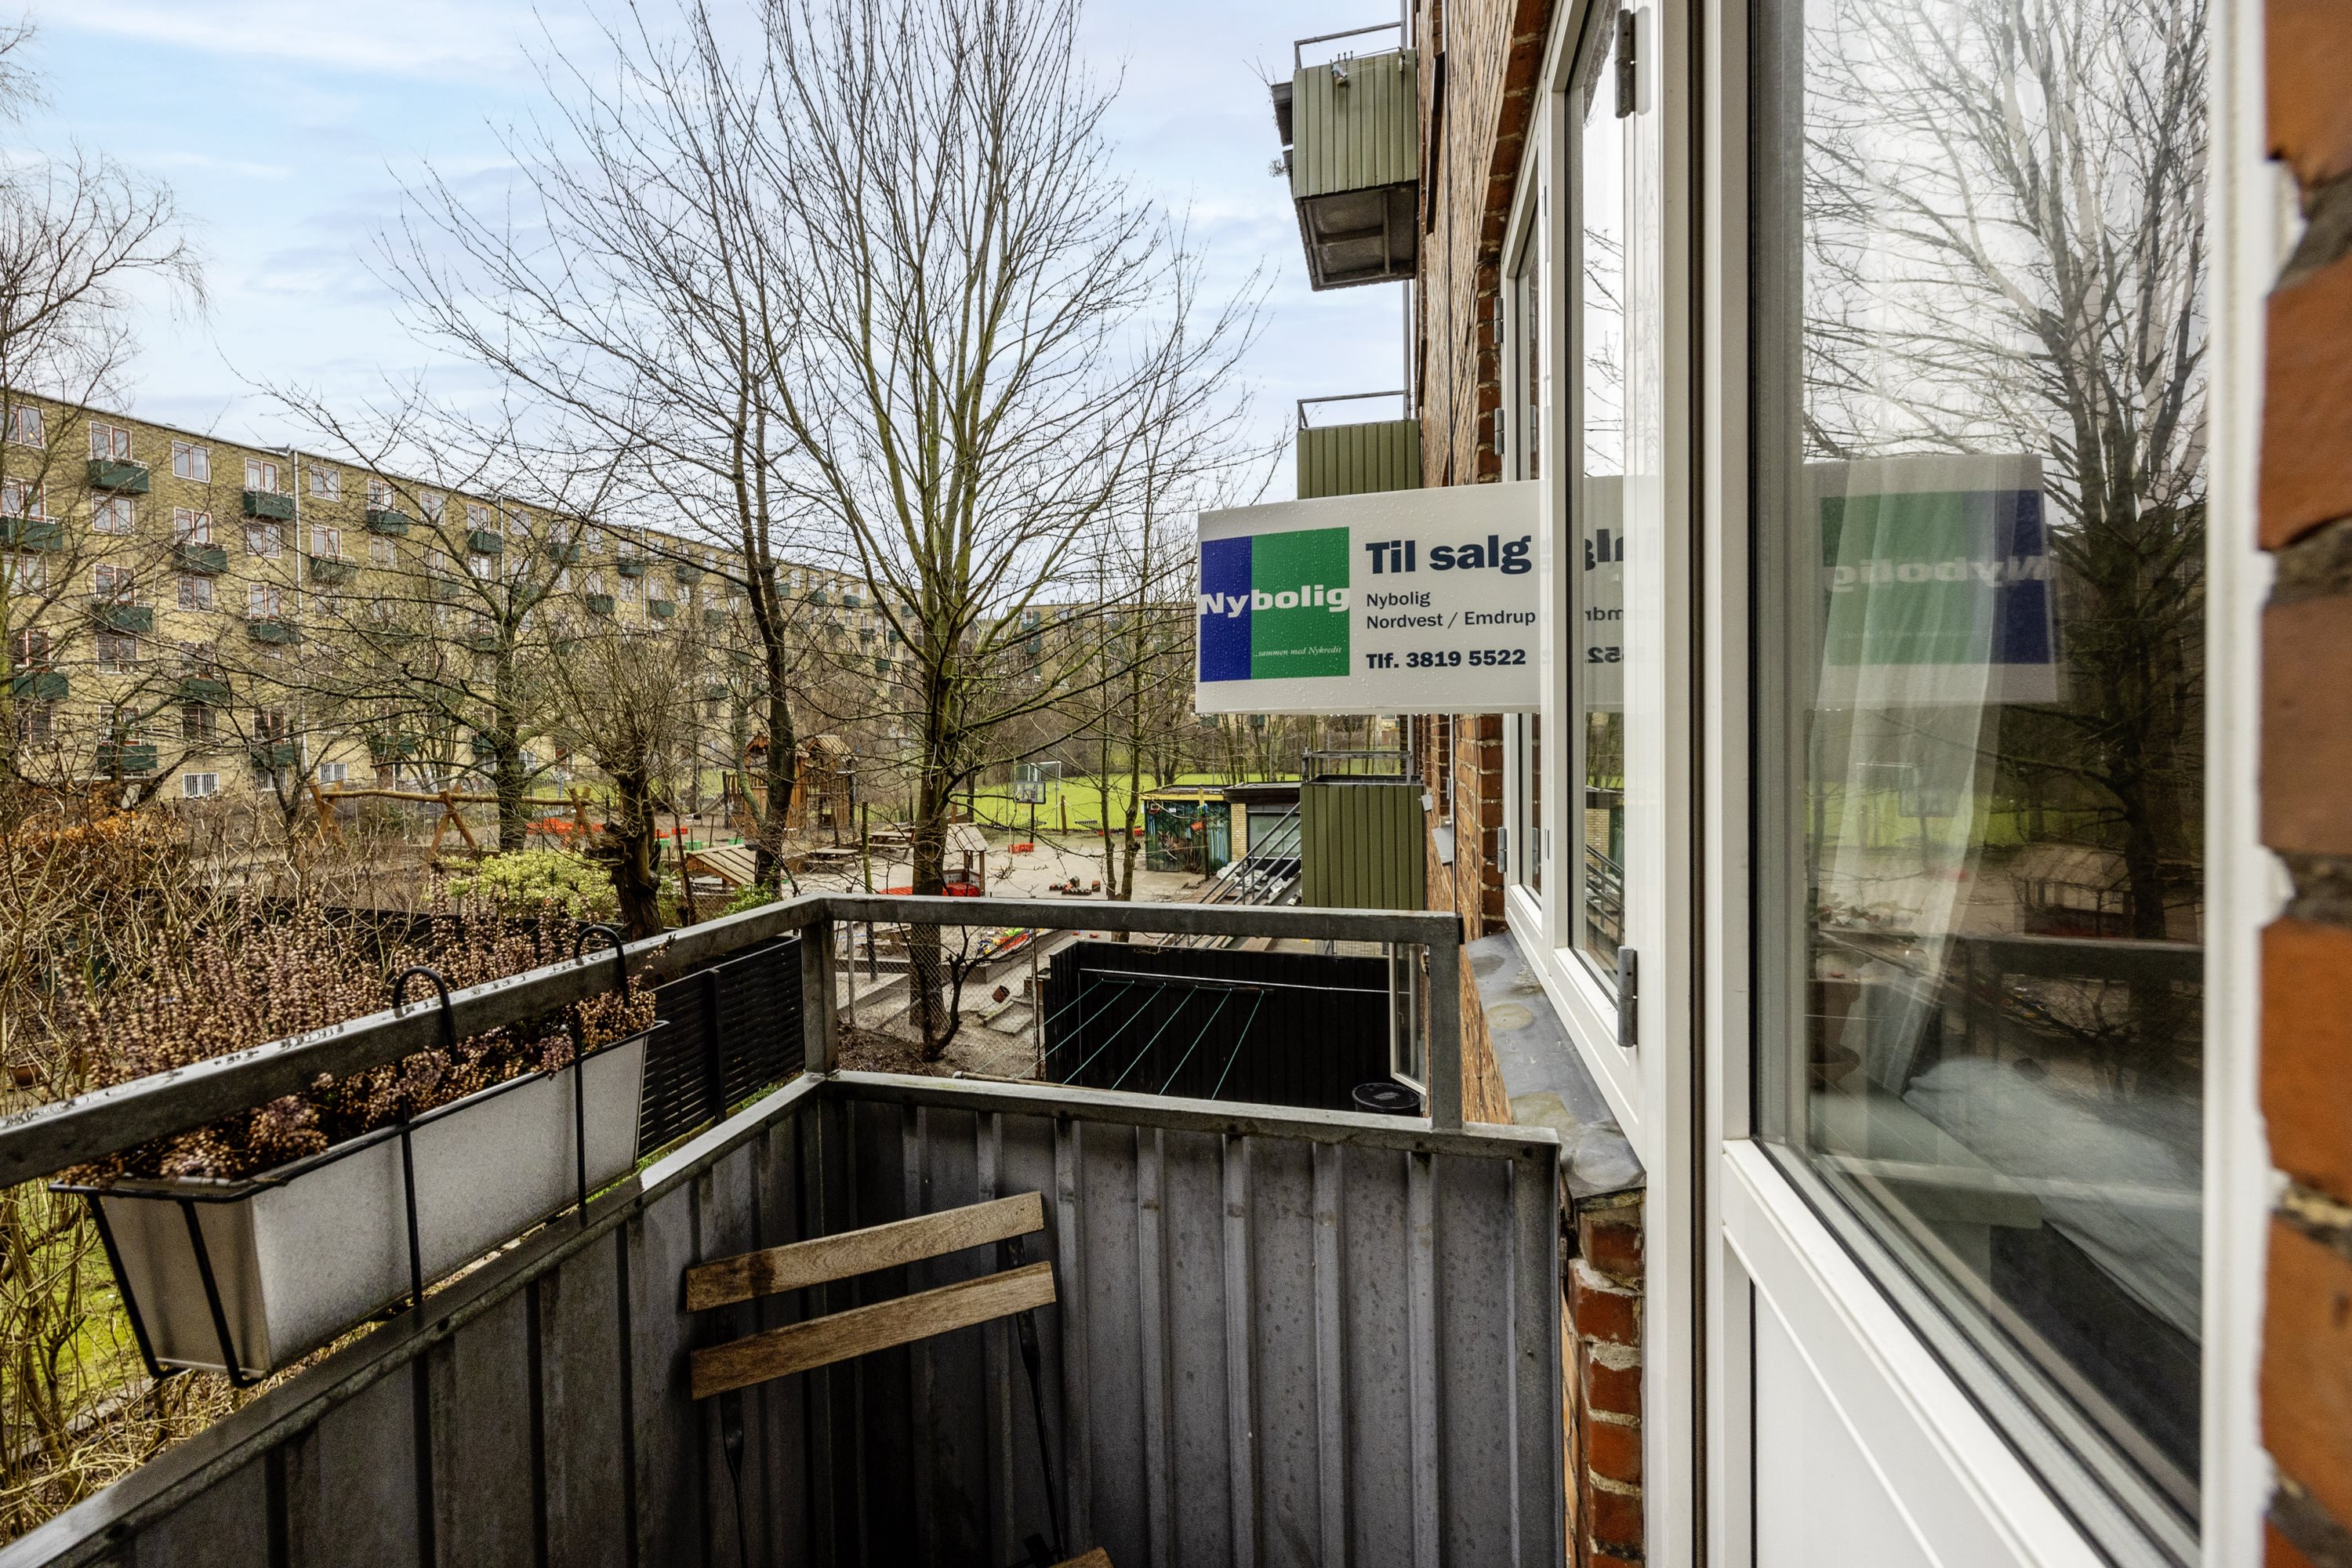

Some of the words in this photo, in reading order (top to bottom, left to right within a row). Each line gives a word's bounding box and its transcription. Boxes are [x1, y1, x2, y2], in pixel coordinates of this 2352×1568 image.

[1366, 540, 1415, 574] Til
[1429, 535, 1532, 575] salg
[1200, 584, 1350, 618] Nybolig
[1367, 592, 1431, 609] Nybolig
[1367, 613, 1443, 629] Nordvest
[1447, 612, 1458, 629] /
[1465, 610, 1536, 626] Emdrup
[1290, 647, 1307, 655] med
[1308, 645, 1341, 655] Nykredit
[1366, 653, 1399, 669] Tlf.
[1406, 652, 1461, 668] 3819
[1468, 649, 1526, 666] 5522
